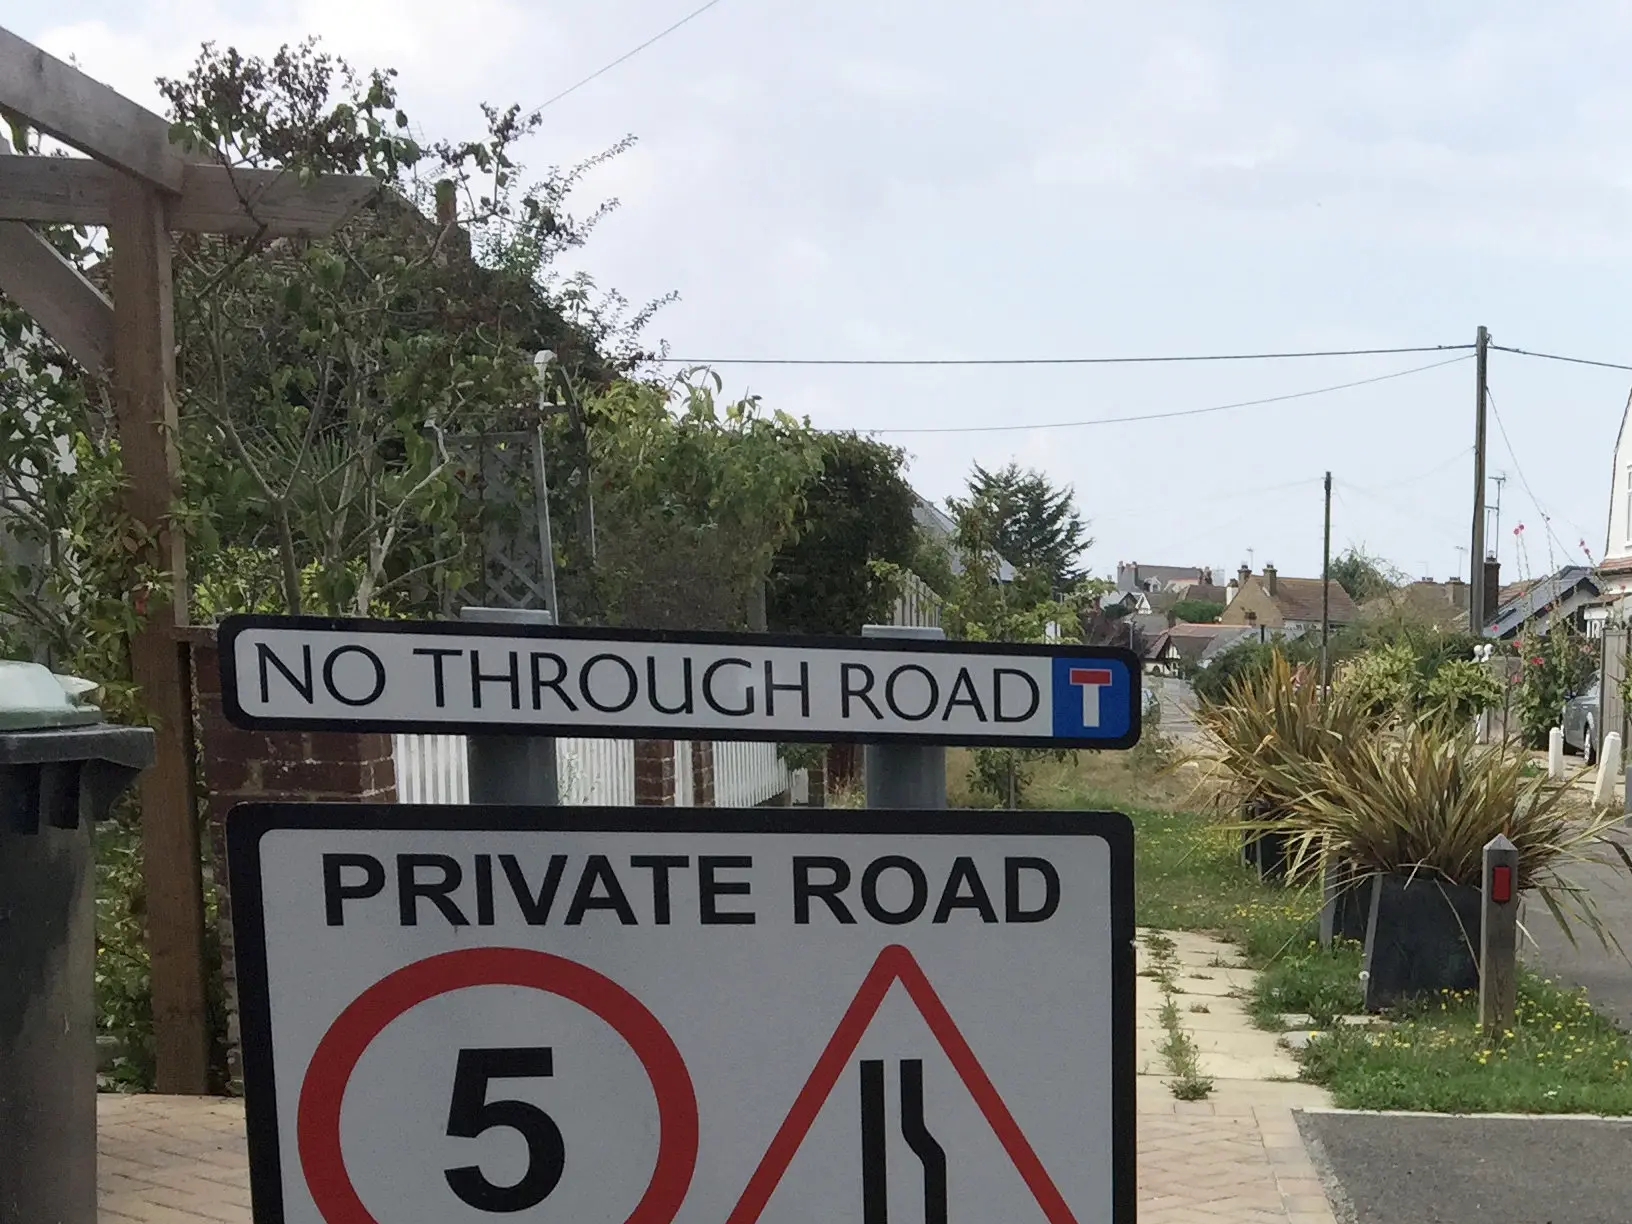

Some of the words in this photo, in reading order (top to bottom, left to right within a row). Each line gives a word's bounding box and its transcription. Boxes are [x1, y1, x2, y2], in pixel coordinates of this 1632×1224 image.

[255, 643, 386, 706] NO
[413, 648, 809, 719] THROUGH
[841, 663, 1039, 722] ROAD
[322, 853, 756, 926] PRIVATE
[792, 855, 1060, 925] ROAD
[444, 1047, 565, 1213] 5
